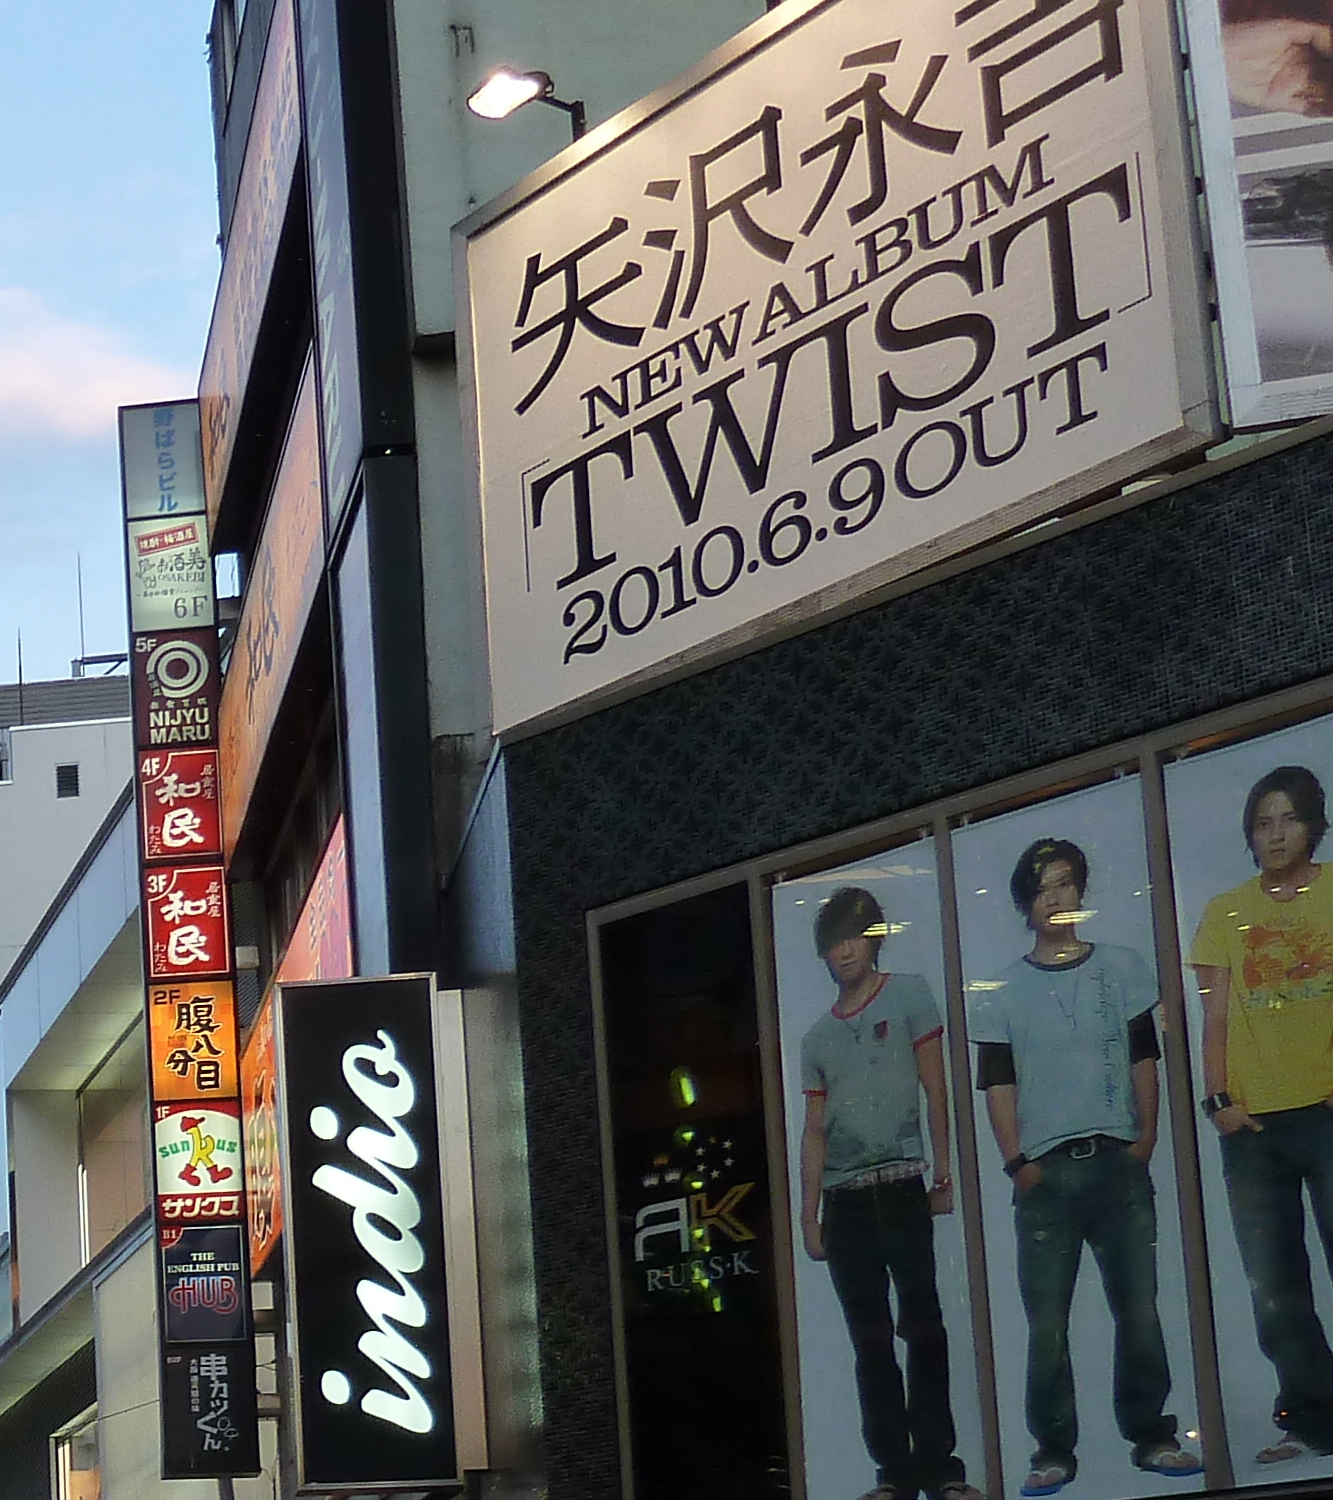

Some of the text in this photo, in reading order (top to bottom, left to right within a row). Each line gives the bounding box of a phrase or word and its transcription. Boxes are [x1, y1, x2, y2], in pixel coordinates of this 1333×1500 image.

[512, 0, 1126, 413] 矢沢永吉
[580, 134, 1055, 437] NEW ALBUM
[174, 596, 208, 618] 6F
[136, 637, 158, 653] 5F
[149, 706, 209, 728] NIJYU
[150, 725, 211, 744] MARU
[141, 758, 161, 775] 4F
[155, 773, 205, 847] 和民
[147, 875, 167, 894] 3F
[160, 890, 211, 967] 和民
[153, 989, 181, 1006] 2F
[165, 995, 222, 1090] 腹八分目
[155, 1106, 171, 1119] 1F
[161, 1196, 241, 1219] サンクス
[162, 1228, 178, 1241] B1
[309, 1027, 434, 1437] indio
[191, 1251, 215, 1261] THE
[167, 1262, 241, 1274] ENGLISH PUB
[169, 1277, 240, 1315] HUB
